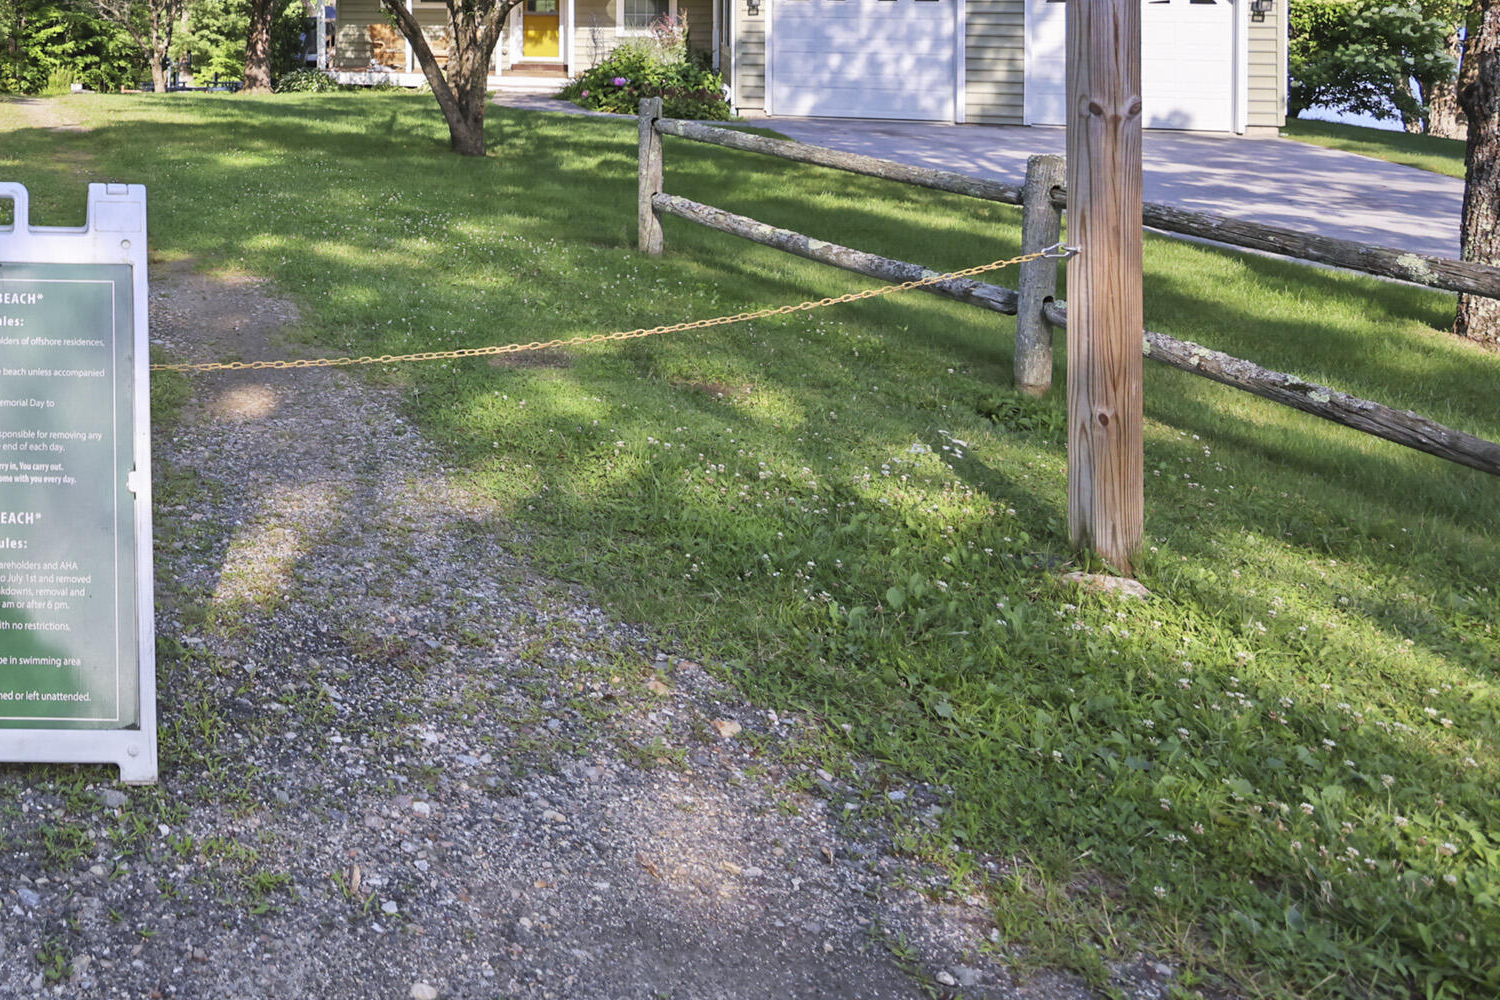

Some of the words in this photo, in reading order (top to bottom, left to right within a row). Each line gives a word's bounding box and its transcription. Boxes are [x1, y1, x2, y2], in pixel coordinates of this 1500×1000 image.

[20, 336, 30, 345] of
[30, 336, 62, 346] offshore
[2, 367, 26, 376] beach
[27, 367, 52, 376] unless
[53, 368, 105, 379] accompanied
[36, 430, 48, 439] for
[49, 430, 86, 441] removing
[87, 433, 102, 441] any
[2, 442, 18, 451] end
[18, 442, 28, 451] of
[28, 442, 48, 451] each
[48, 442, 65, 453] day.
[42, 561, 58, 570] and
[59, 561, 78, 571] AHA
[7, 573, 23, 585] July
[25, 573, 36, 583] 1st
[38, 573, 54, 583] and
[55, 574, 92, 584] removed
[35, 586, 68, 596] removal
[69, 587, 85, 597] and
[26, 599, 46, 609] after
[46, 600, 52, 610] 6
[54, 602, 70, 612] pm.
[9, 655, 17, 665] in
[18, 655, 61, 668] swimming
[63, 659, 81, 667] area
[14, 693, 24, 701] or
[25, 691, 40, 701] left
[40, 691, 91, 702] unattended.
